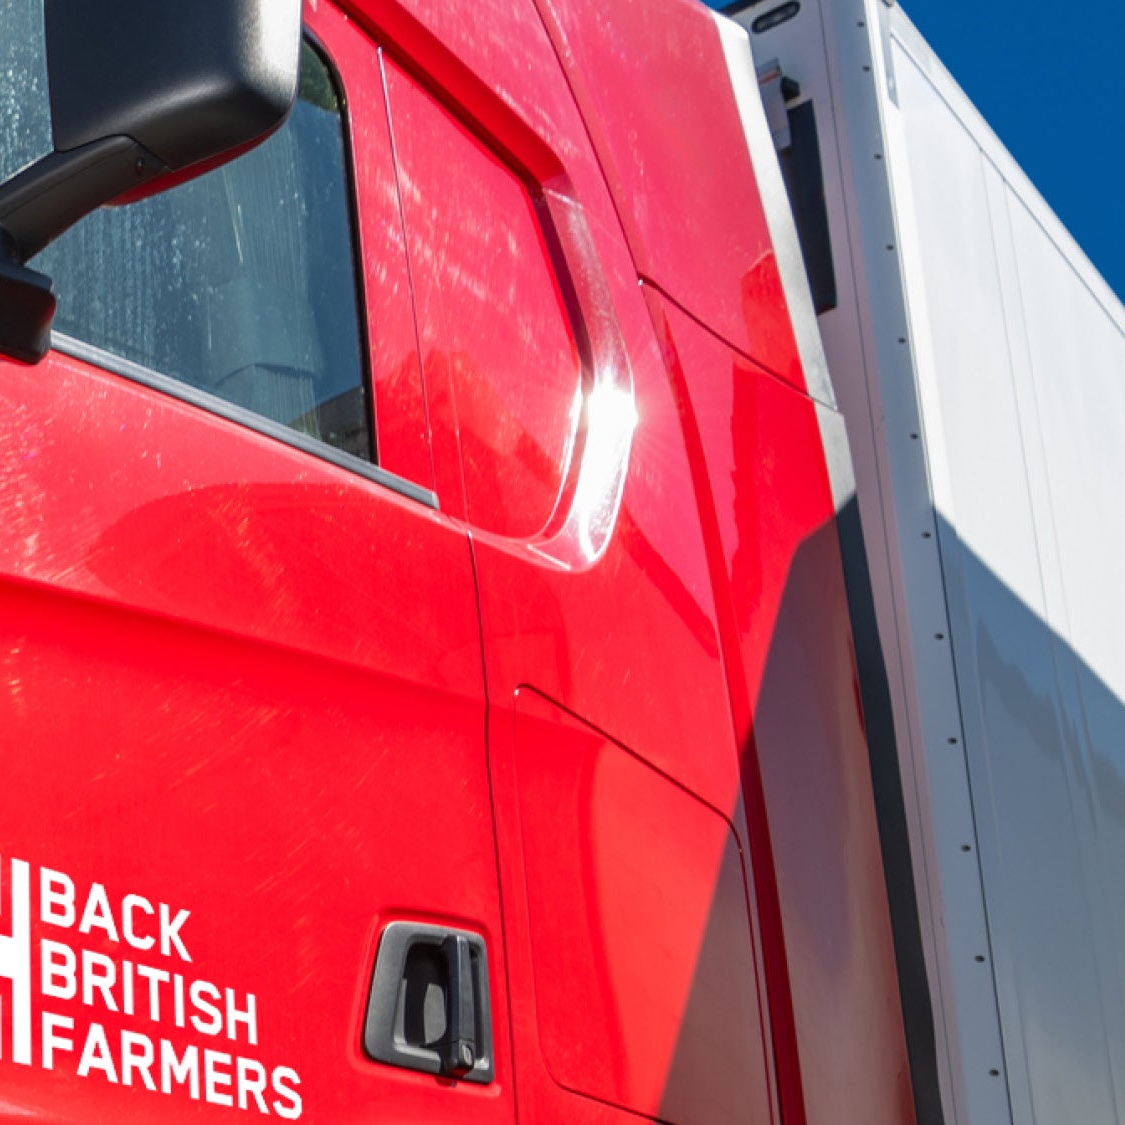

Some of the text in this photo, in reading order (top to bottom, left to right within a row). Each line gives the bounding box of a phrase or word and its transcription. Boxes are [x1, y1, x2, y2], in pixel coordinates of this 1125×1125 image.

[40, 866, 193, 963] BACK
[40, 938, 259, 1046] BRITISH
[41, 1011, 304, 1121] FARMERS
